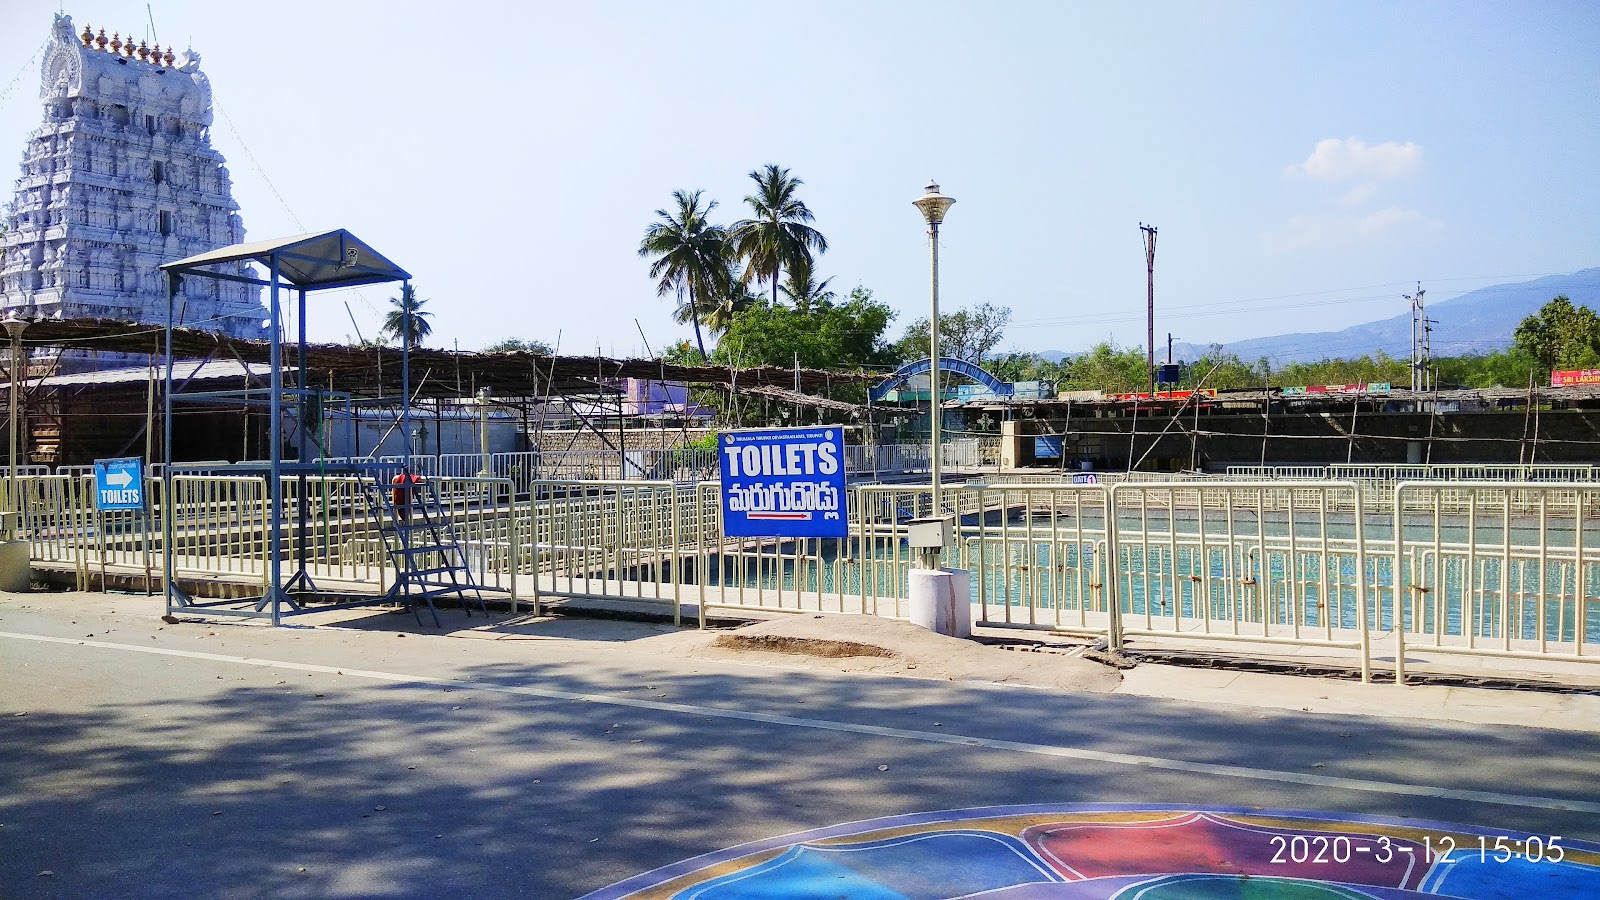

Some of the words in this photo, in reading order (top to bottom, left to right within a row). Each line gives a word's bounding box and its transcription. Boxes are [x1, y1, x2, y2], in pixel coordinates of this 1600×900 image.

[725, 442, 838, 476] TOILETS
[1073, 475, 1087, 483] GATE
[101, 489, 139, 504] TOILETS
[728, 481, 839, 520] మరుగుదొడ్లు
